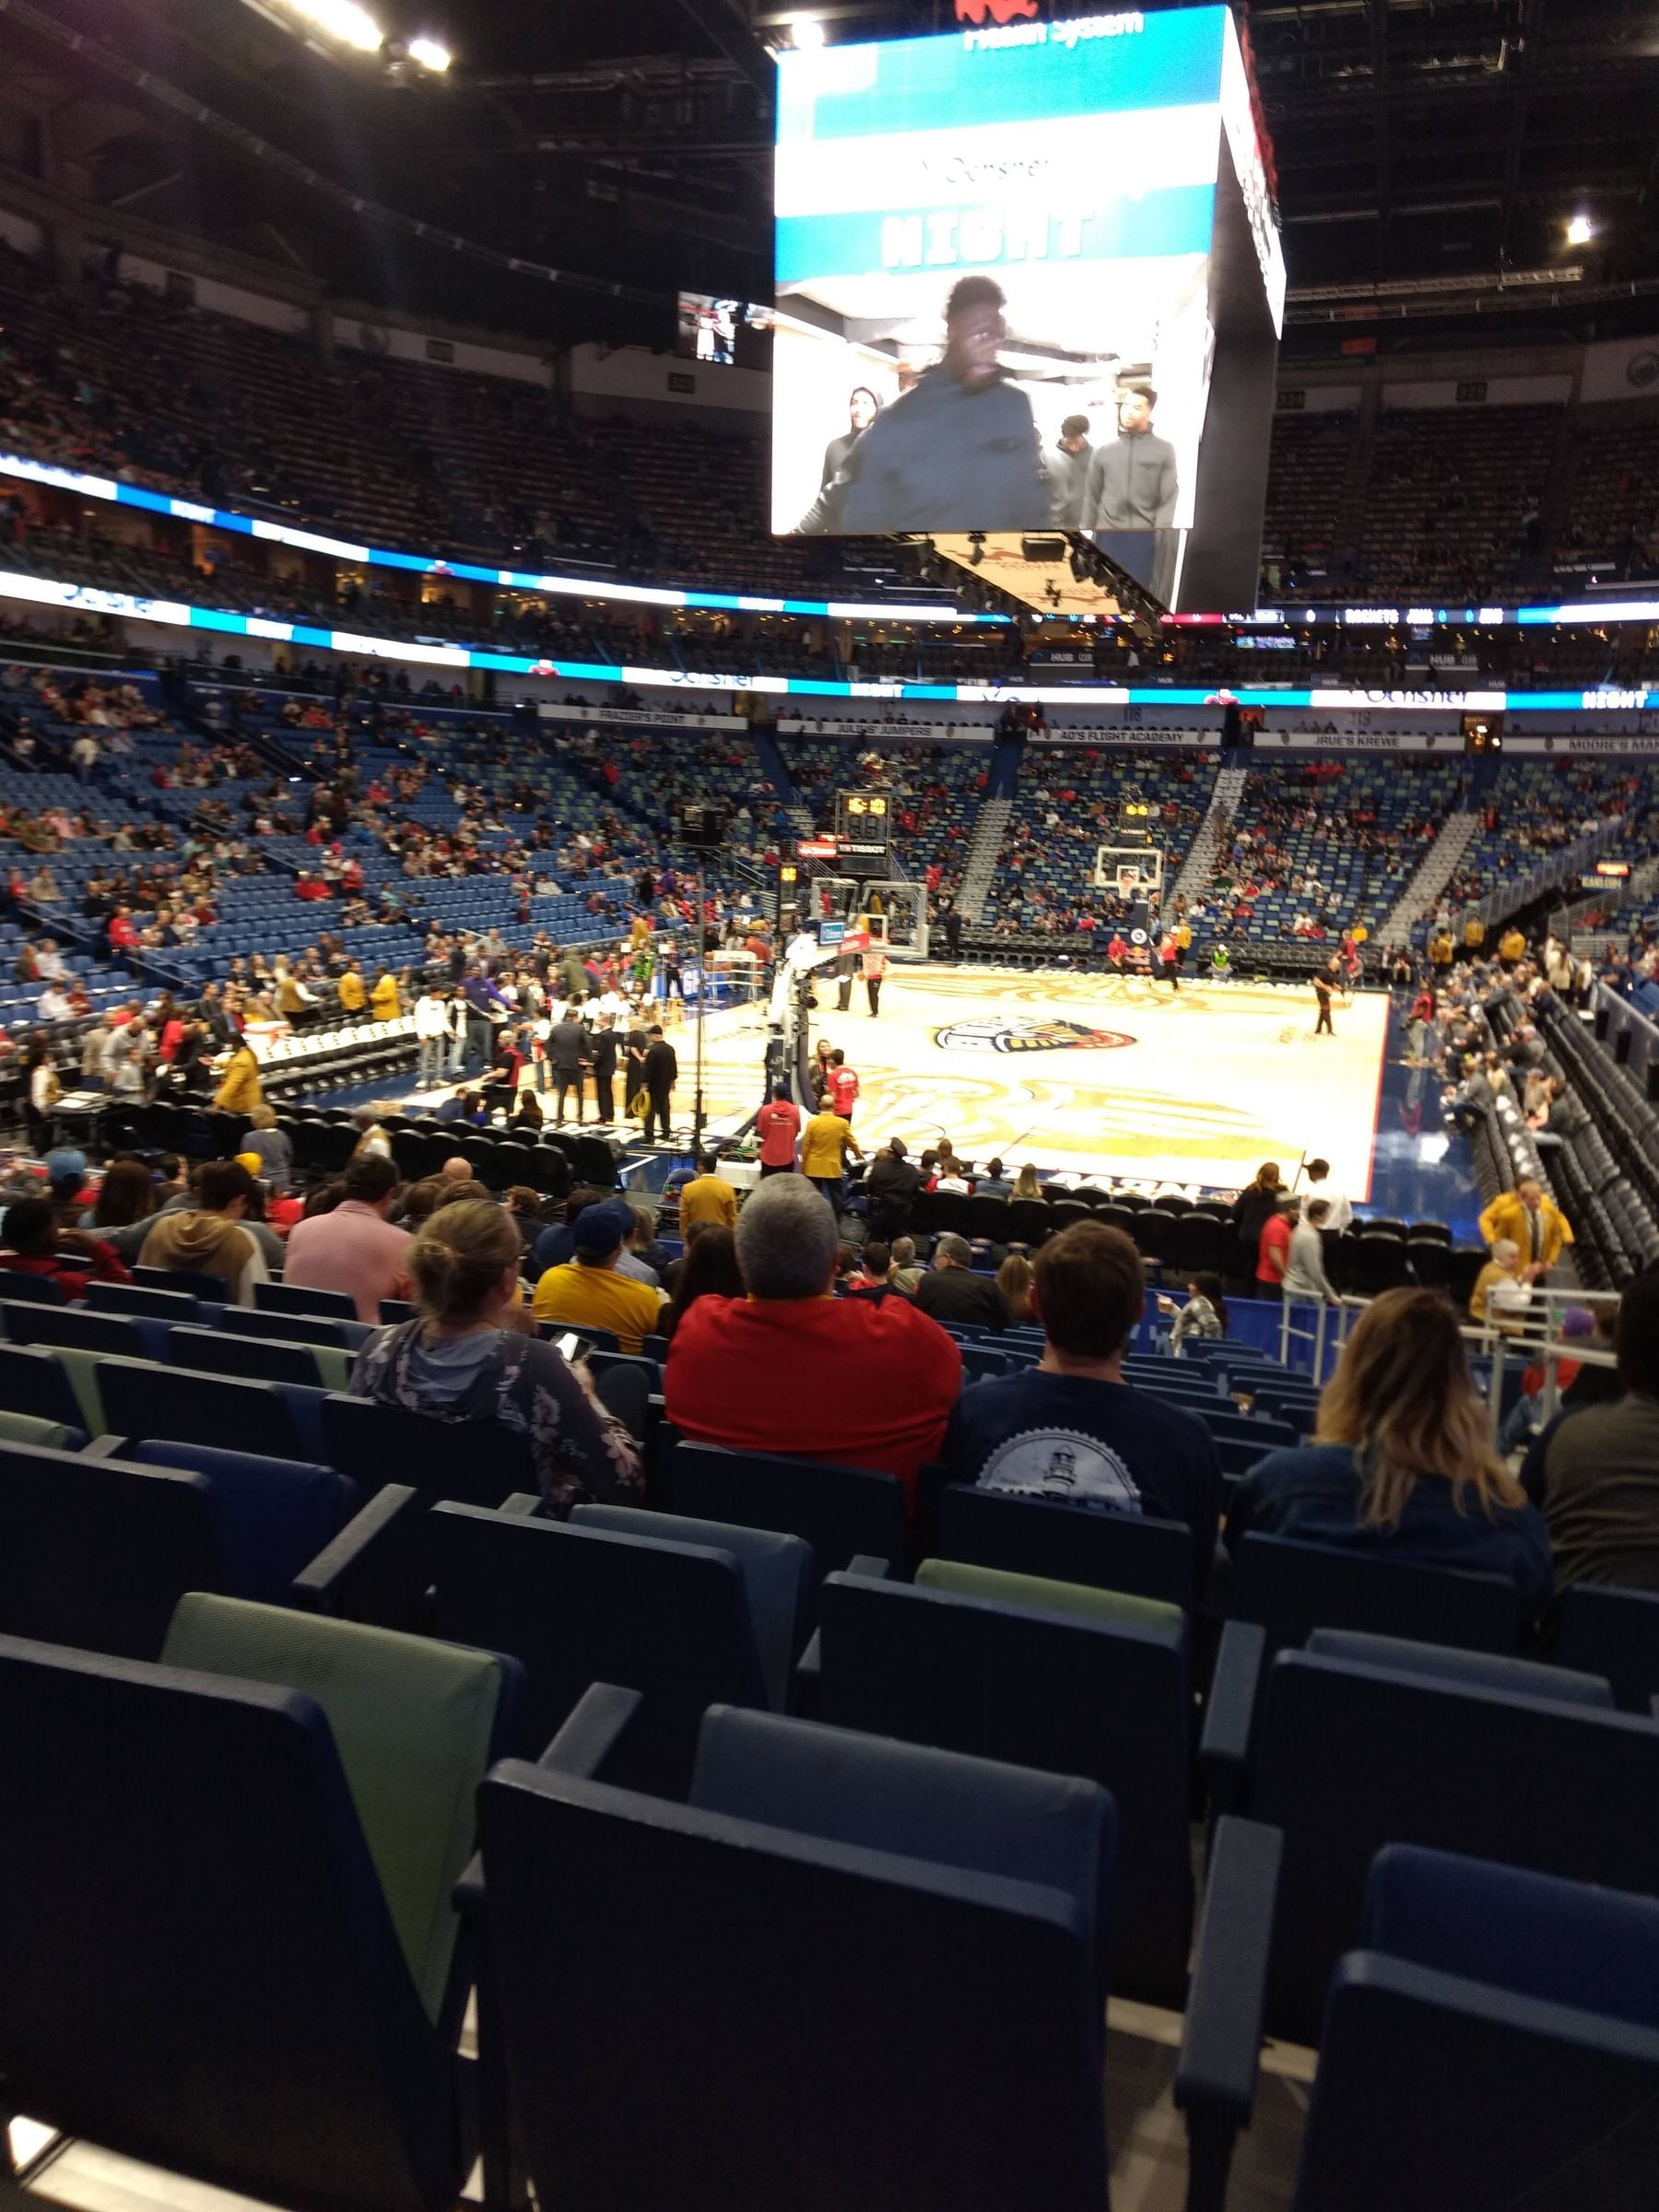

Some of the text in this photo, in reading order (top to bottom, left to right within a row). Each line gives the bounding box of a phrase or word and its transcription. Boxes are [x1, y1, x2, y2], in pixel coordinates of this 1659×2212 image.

[882, 207, 1094, 268] NIGHT
[1582, 690, 1649, 709] NIGHT
[879, 724, 932, 736] JUMPERS
[1088, 732, 1126, 742] FLIGHT
[1129, 733, 1183, 743] ACADEMY
[1357, 736, 1400, 747] KREWE
